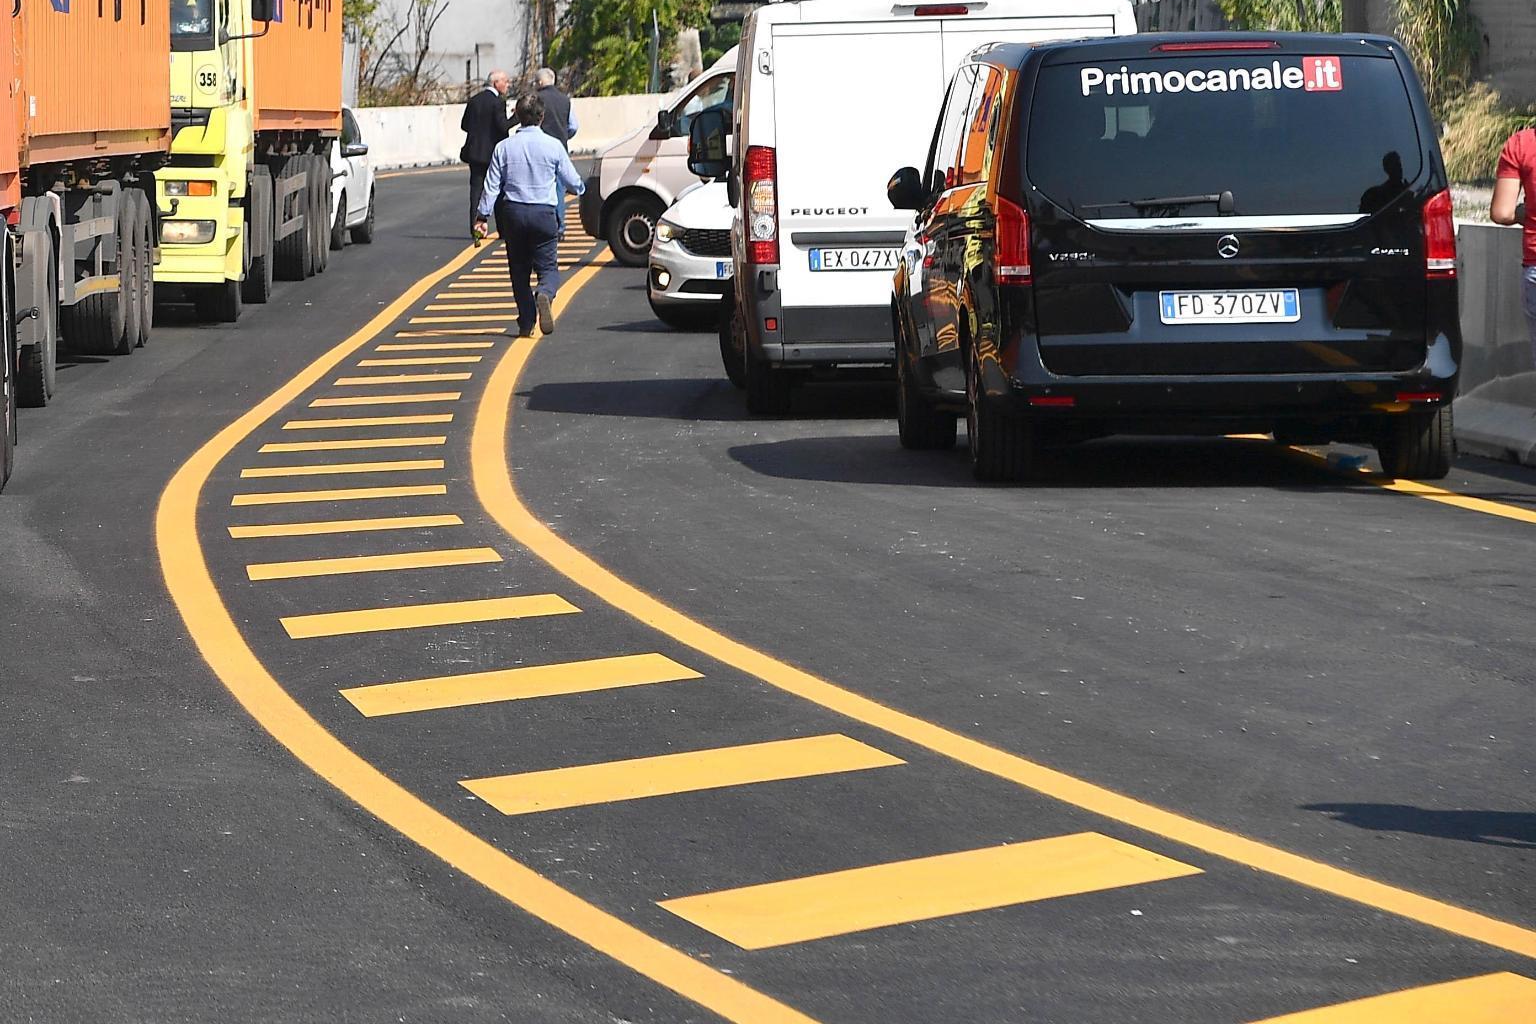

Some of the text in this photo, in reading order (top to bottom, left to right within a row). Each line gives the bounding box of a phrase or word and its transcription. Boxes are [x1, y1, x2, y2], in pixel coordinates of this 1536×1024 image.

[199, 72, 217, 87] 358
[1080, 60, 1340, 96] Primocanale.it
[791, 207, 869, 215] PEUGEOT
[824, 251, 843, 267] EX
[1178, 295, 1204, 316] FD
[1213, 293, 1280, 315] 370ZV
